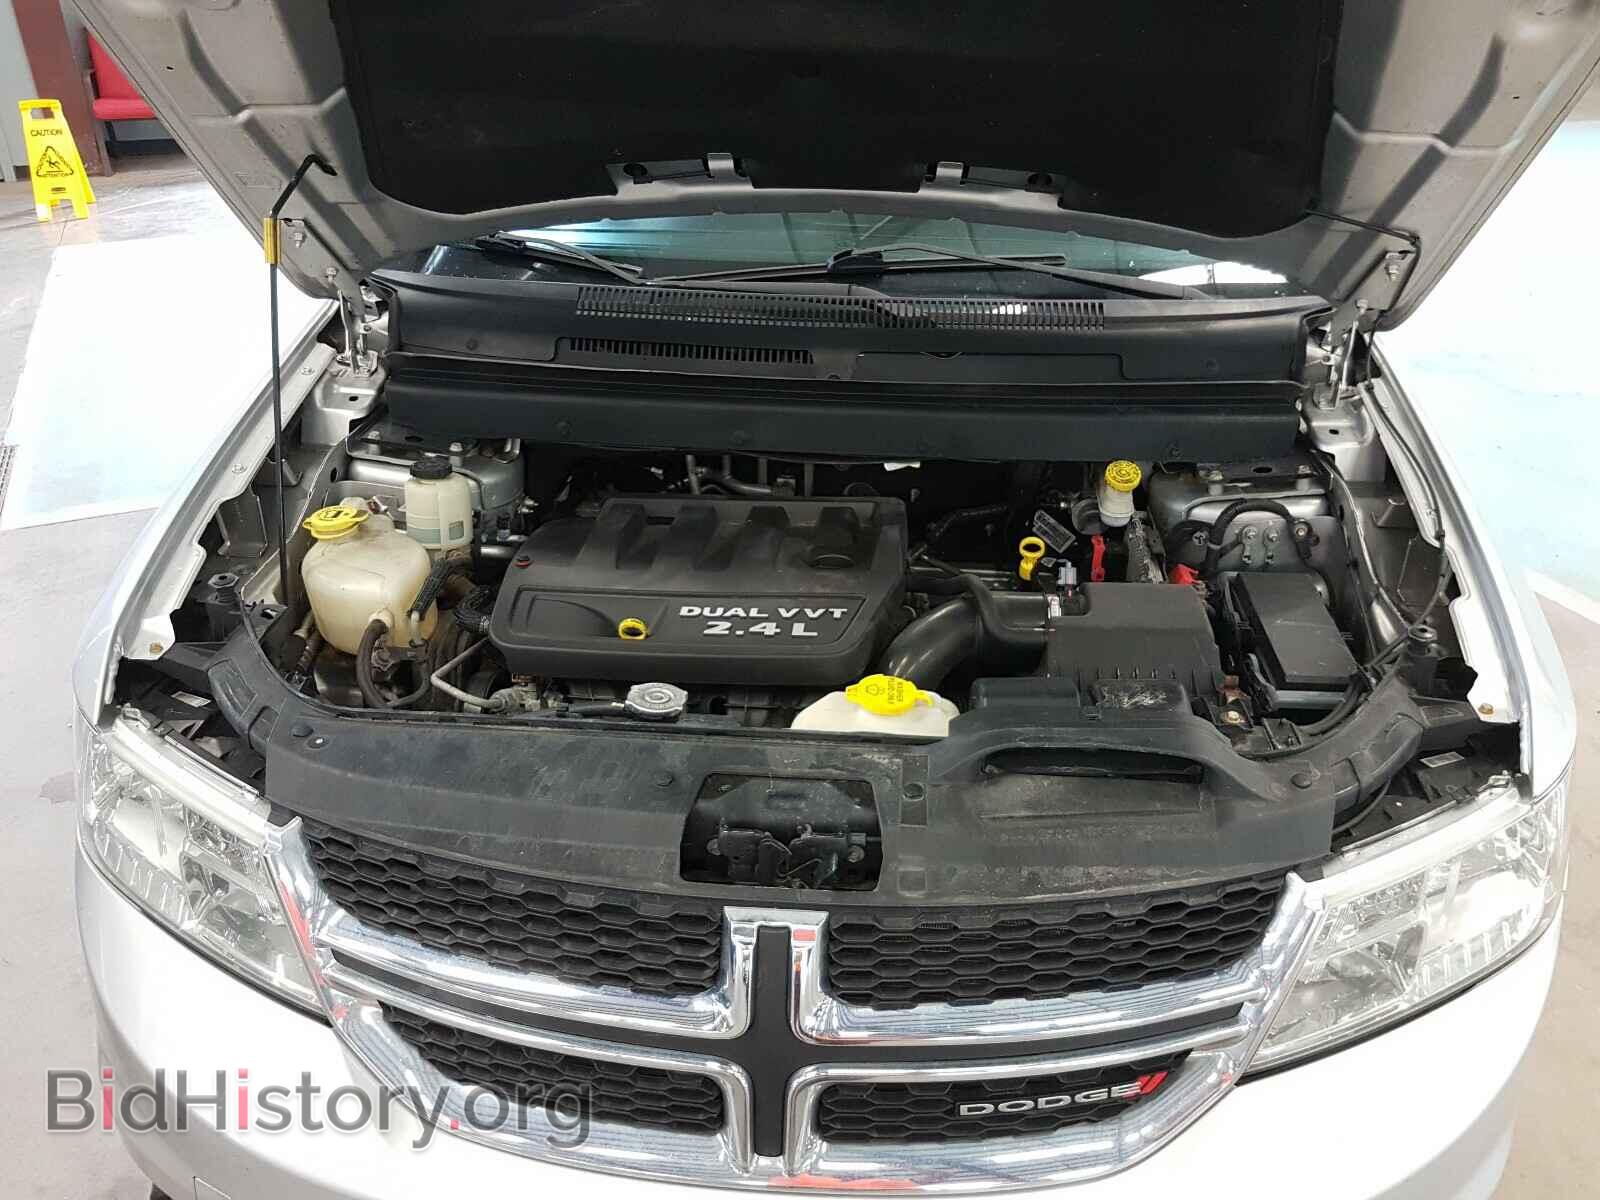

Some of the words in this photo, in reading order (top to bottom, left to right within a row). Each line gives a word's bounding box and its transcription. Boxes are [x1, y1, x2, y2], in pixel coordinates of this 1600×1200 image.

[30, 128, 63, 137] CAUTION
[679, 606, 769, 618] DUAL
[777, 607, 848, 619] VVT
[959, 1080, 1142, 1116] DODGE
